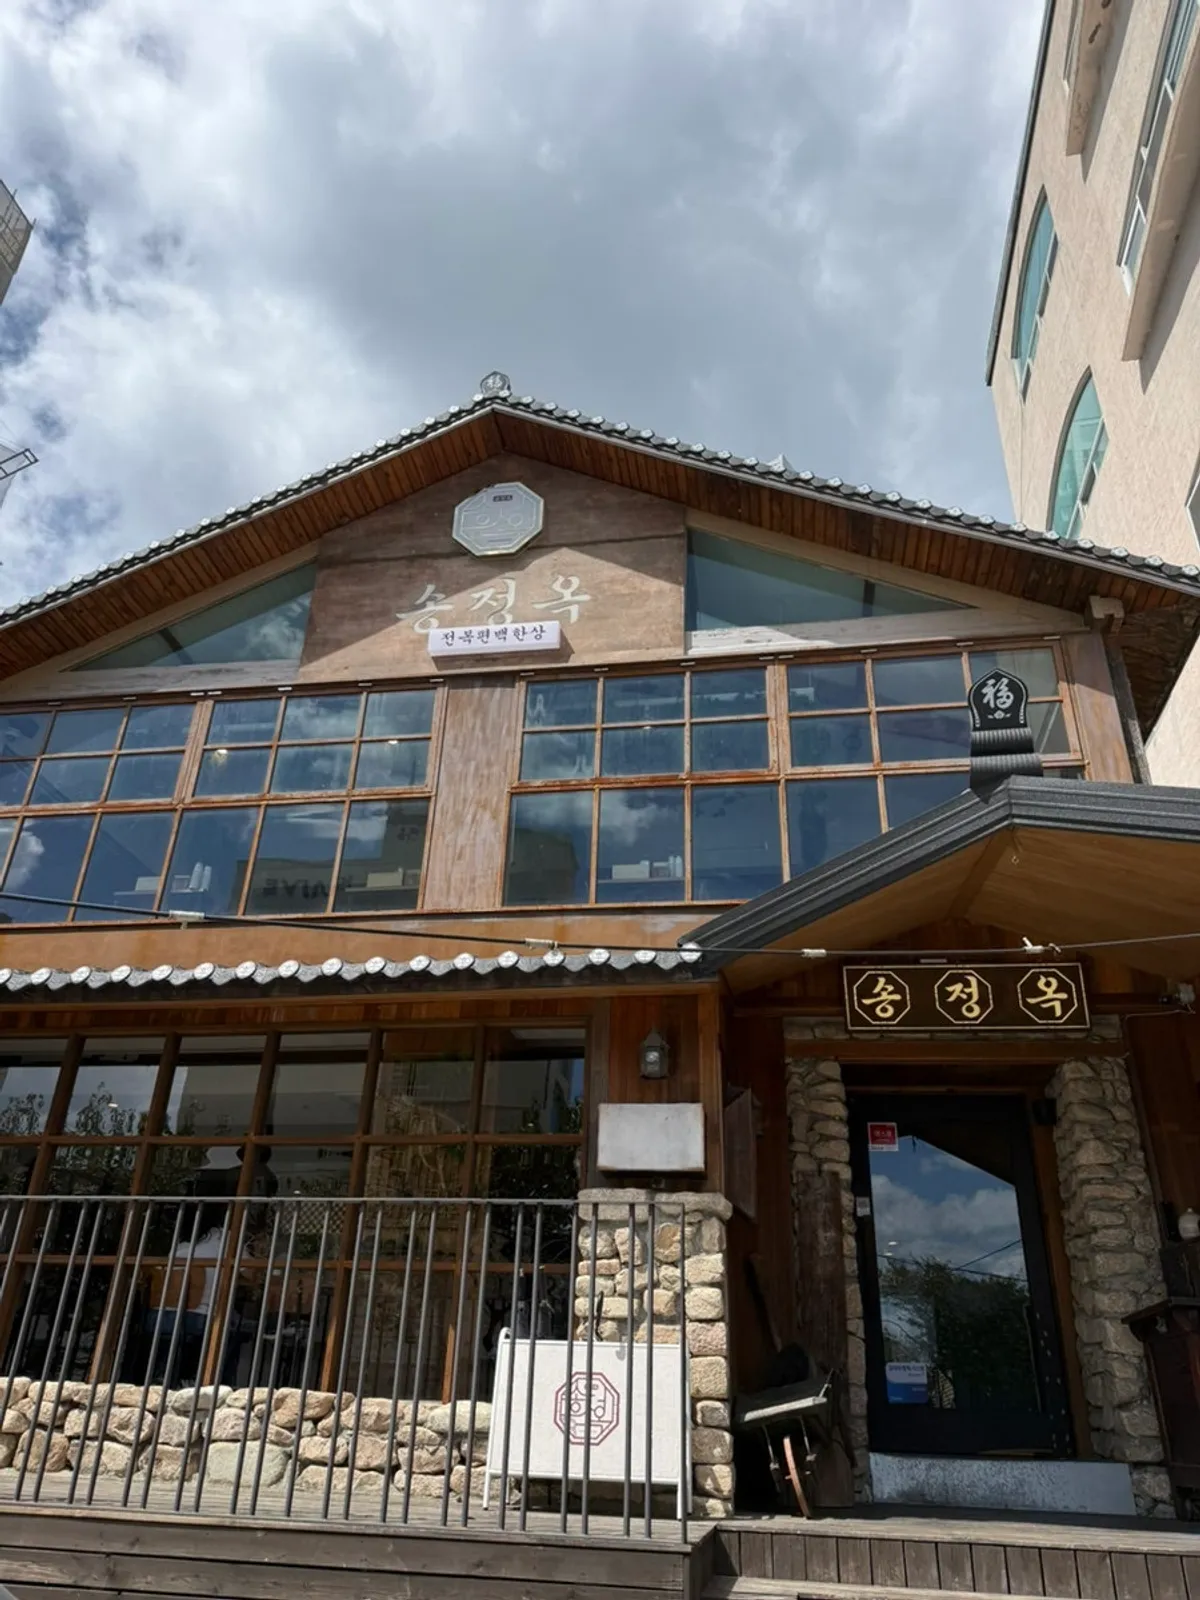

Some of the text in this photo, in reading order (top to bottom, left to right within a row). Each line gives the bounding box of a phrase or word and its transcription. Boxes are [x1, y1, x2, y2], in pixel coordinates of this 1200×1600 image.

[396, 575, 592, 634] 송정옥
[981, 677, 1015, 710] 福
[861, 975, 1069, 1018] 송정옥
